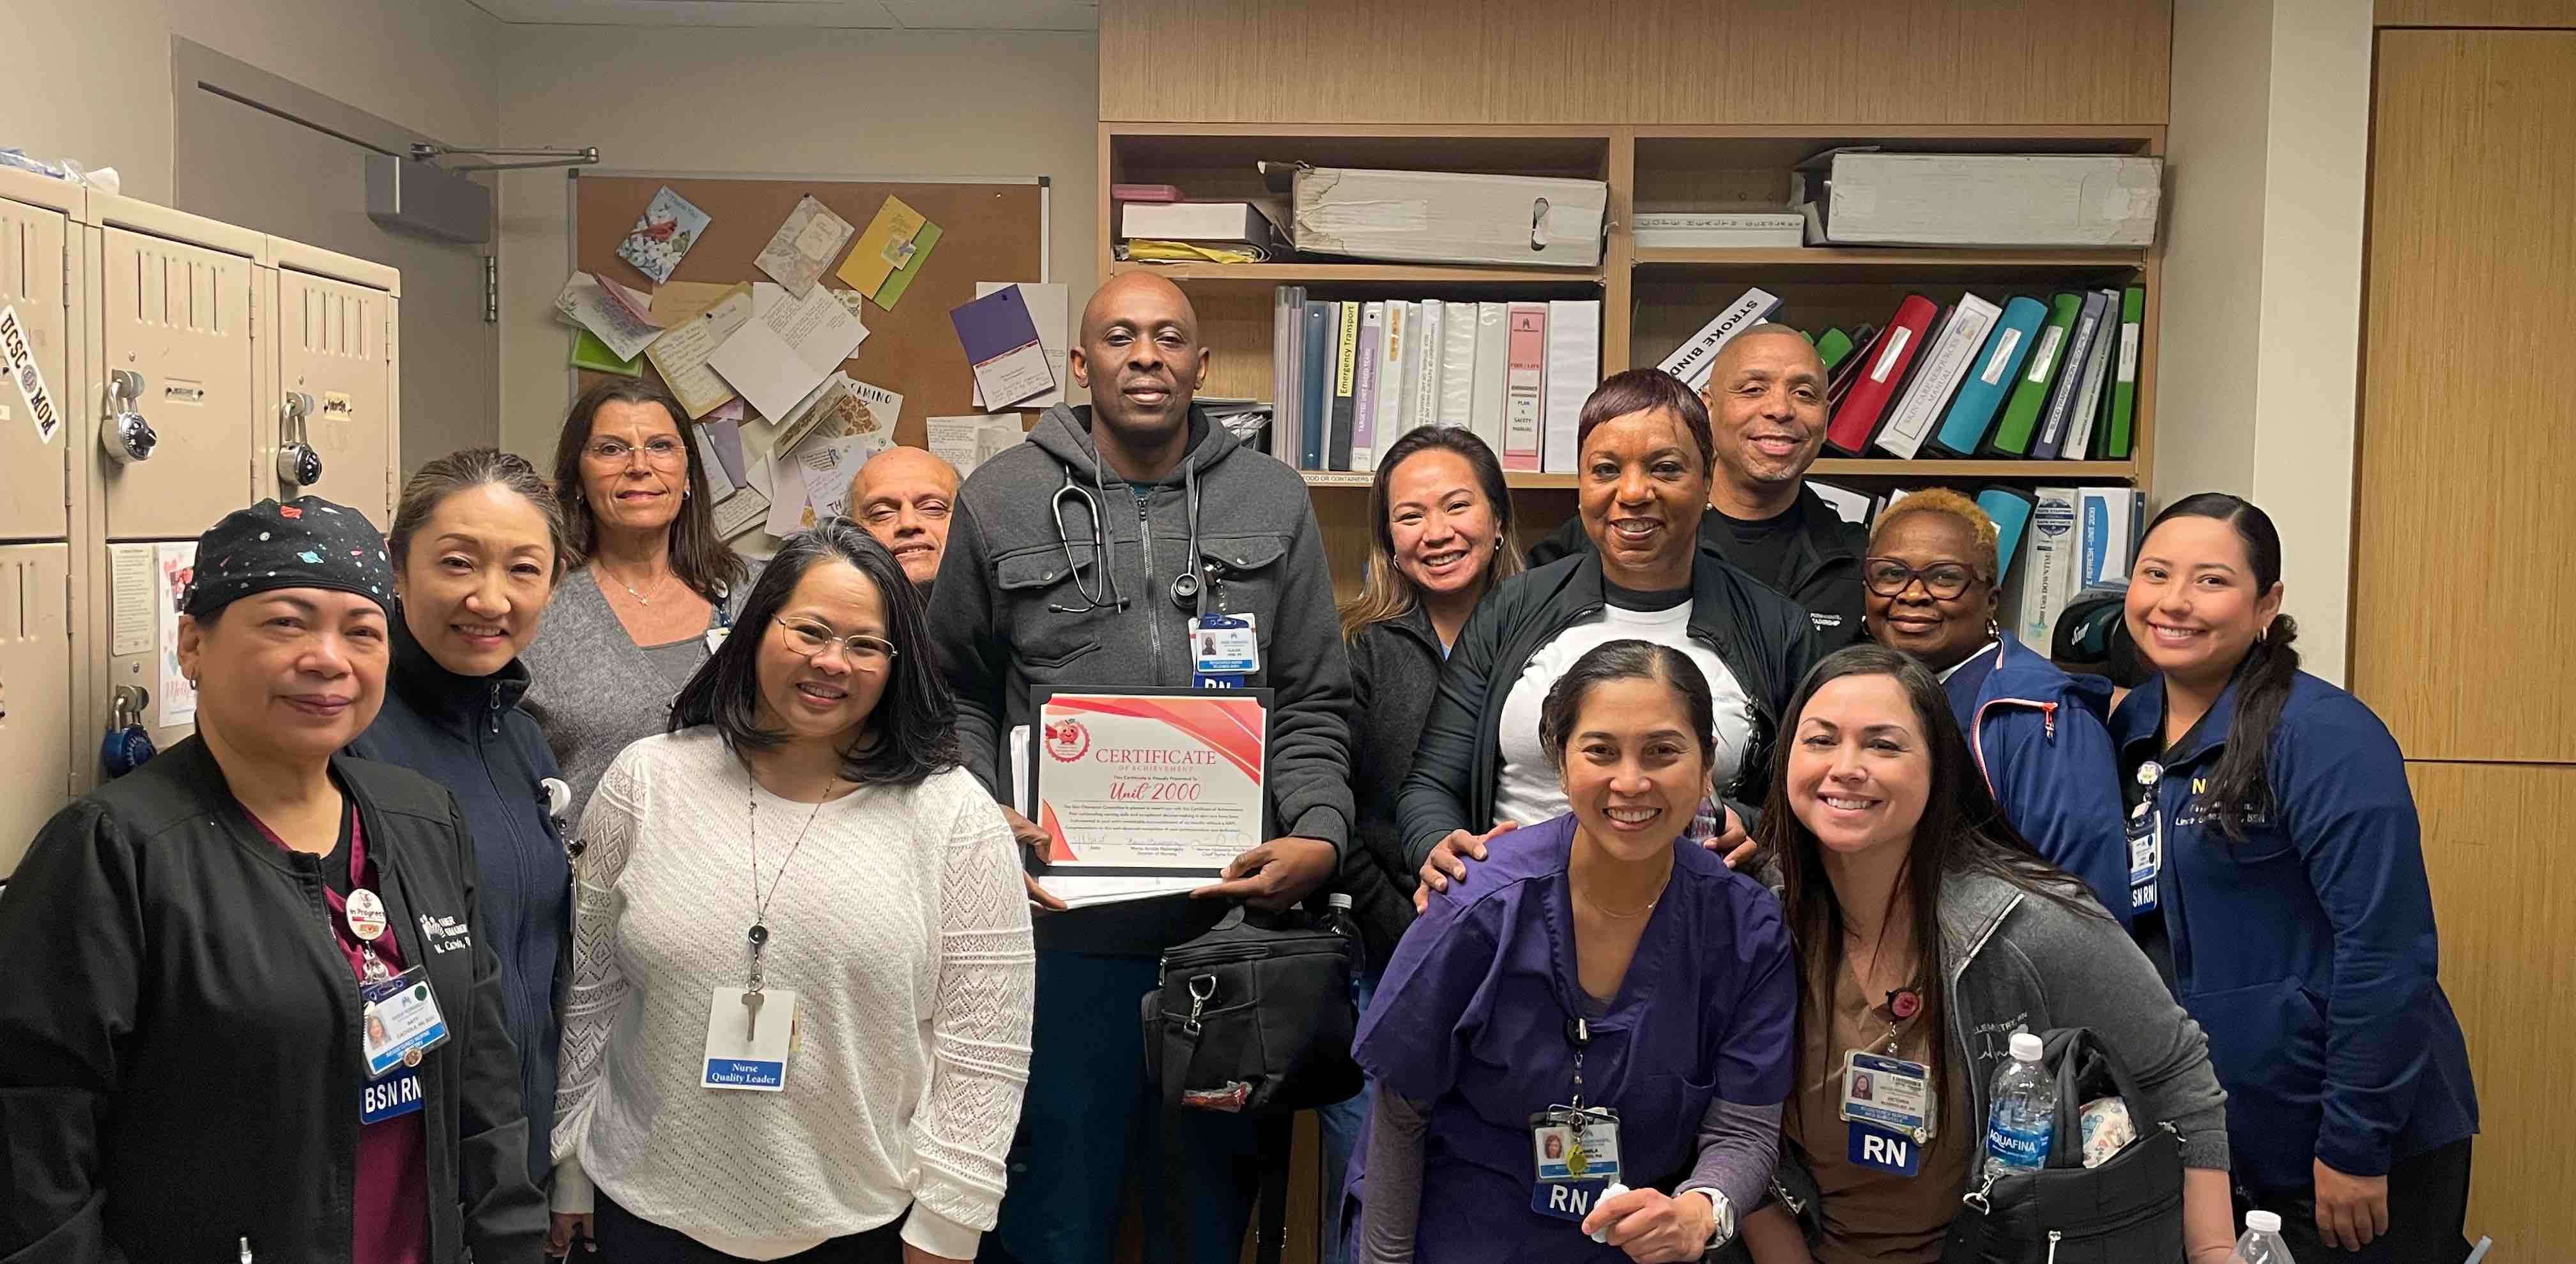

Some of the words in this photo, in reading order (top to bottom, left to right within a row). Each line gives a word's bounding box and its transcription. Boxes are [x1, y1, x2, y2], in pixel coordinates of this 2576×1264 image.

[1344, 306, 1354, 346] Transport
[1703, 300, 1758, 347] STROKE
[1, 313, 27, 369] UCSC
[1340, 348, 1353, 394] Emergency
[1669, 347, 1704, 379] BIND
[851, 383, 892, 404] CAMINO
[31, 386, 56, 436] MOM
[1096, 749, 1216, 765] CERTIFICATE
[1109, 782, 1147, 801] Unit
[1151, 783, 1201, 800] 2000
[2143, 883, 2154, 903] RN
[712, 1073, 745, 1084] Quality
[746, 1074, 776, 1084] Leader
[732, 1063, 758, 1072] Nurse
[365, 1081, 398, 1114] BSN
[401, 1076, 422, 1104] RN
[1863, 1134, 1906, 1168] RN
[1990, 1129, 2035, 1152] AQUAFINA
[1550, 1184, 1588, 1215] RN
